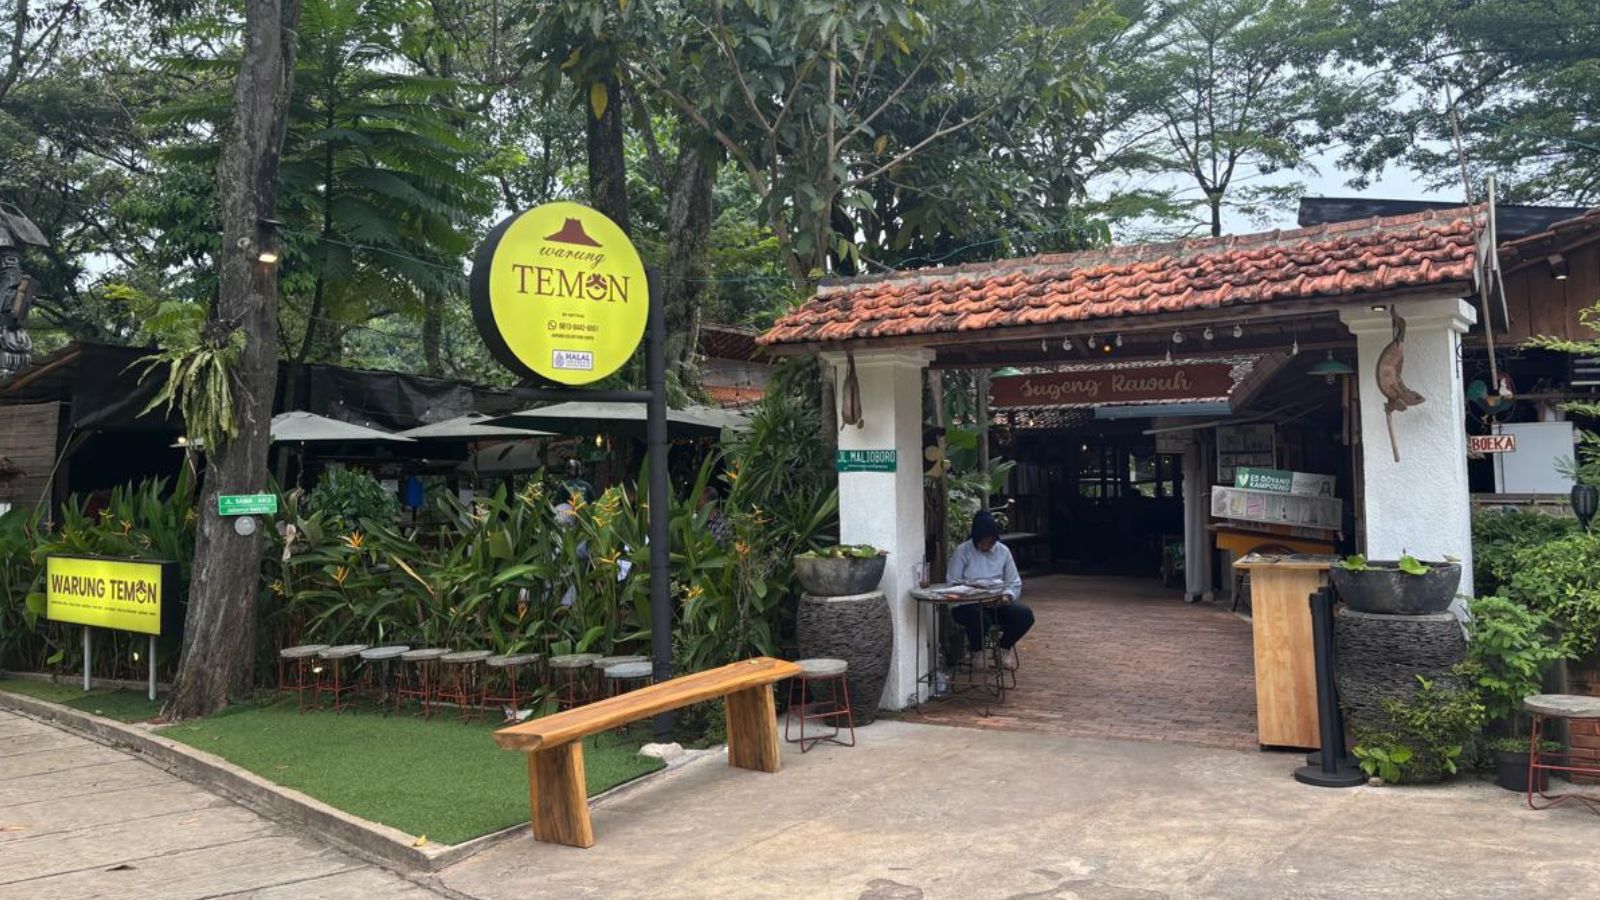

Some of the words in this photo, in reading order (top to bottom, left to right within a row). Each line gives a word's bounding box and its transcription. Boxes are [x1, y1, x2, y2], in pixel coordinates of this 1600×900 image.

[540, 246, 606, 269] warung
[512, 264, 631, 303] TEMON
[1020, 379, 1101, 400] Sugeng
[1471, 437, 1514, 451] BOEKA
[850, 450, 896, 463] MALIOBORO
[1249, 482, 1290, 491] KAMPOENG
[1250, 474, 1259, 482] ES
[51, 573, 106, 598] WARUNG
[110, 579, 157, 604] TEMON
